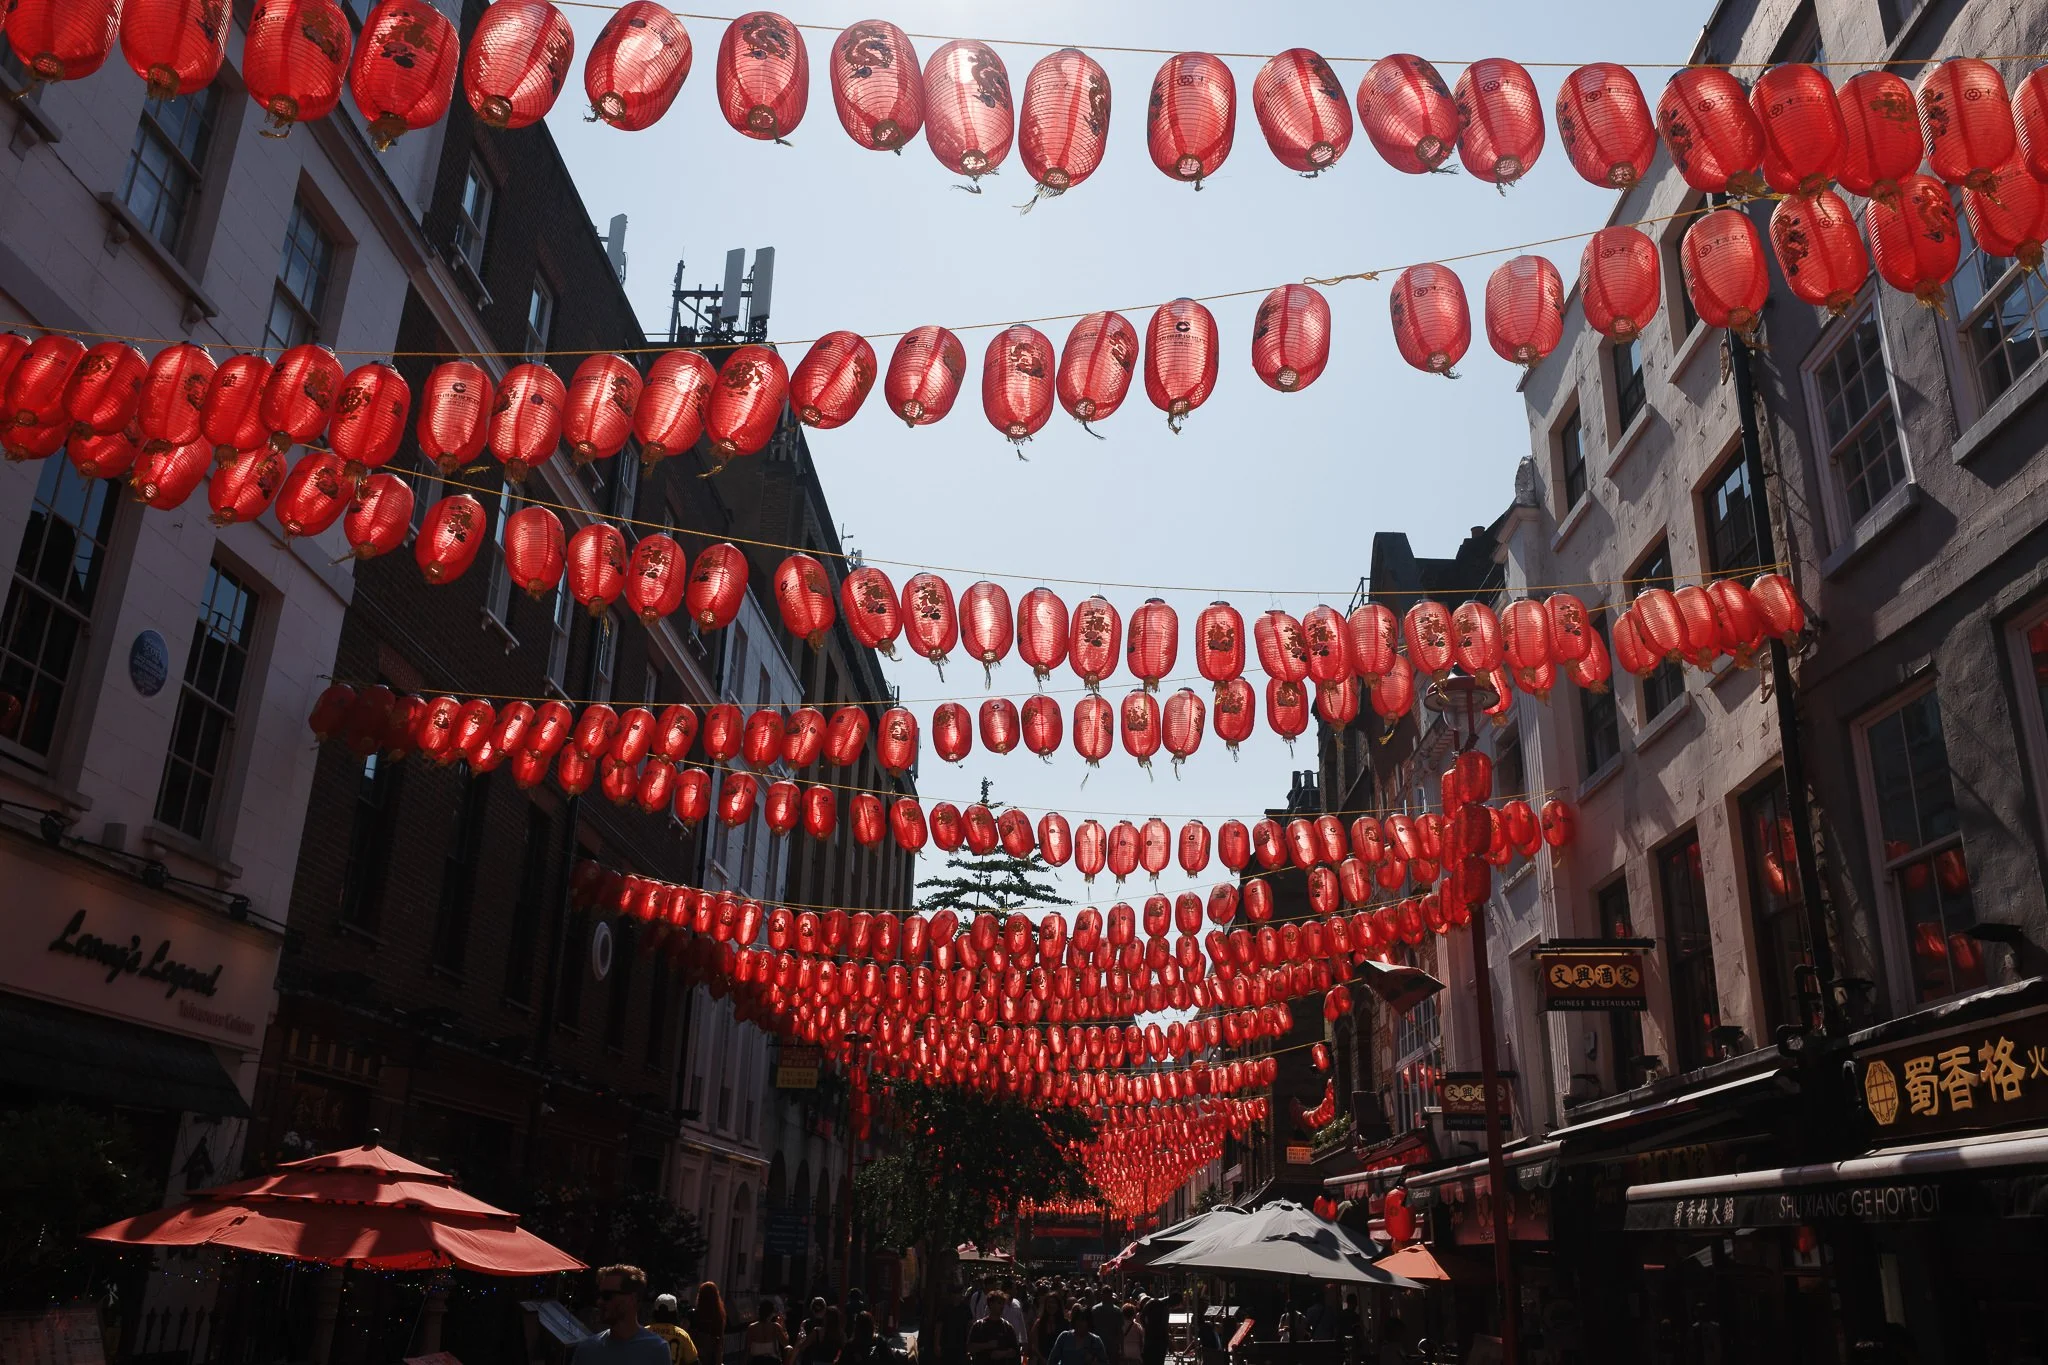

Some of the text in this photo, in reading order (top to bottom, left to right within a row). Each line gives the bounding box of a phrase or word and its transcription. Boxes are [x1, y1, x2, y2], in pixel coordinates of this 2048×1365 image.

[1551, 966, 1637, 986] 文興酒家
[1554, 999, 1641, 1007] CHINESE RESTAURANT
[1779, 1184, 1941, 1219] SHU XIANG GE HOT POT
